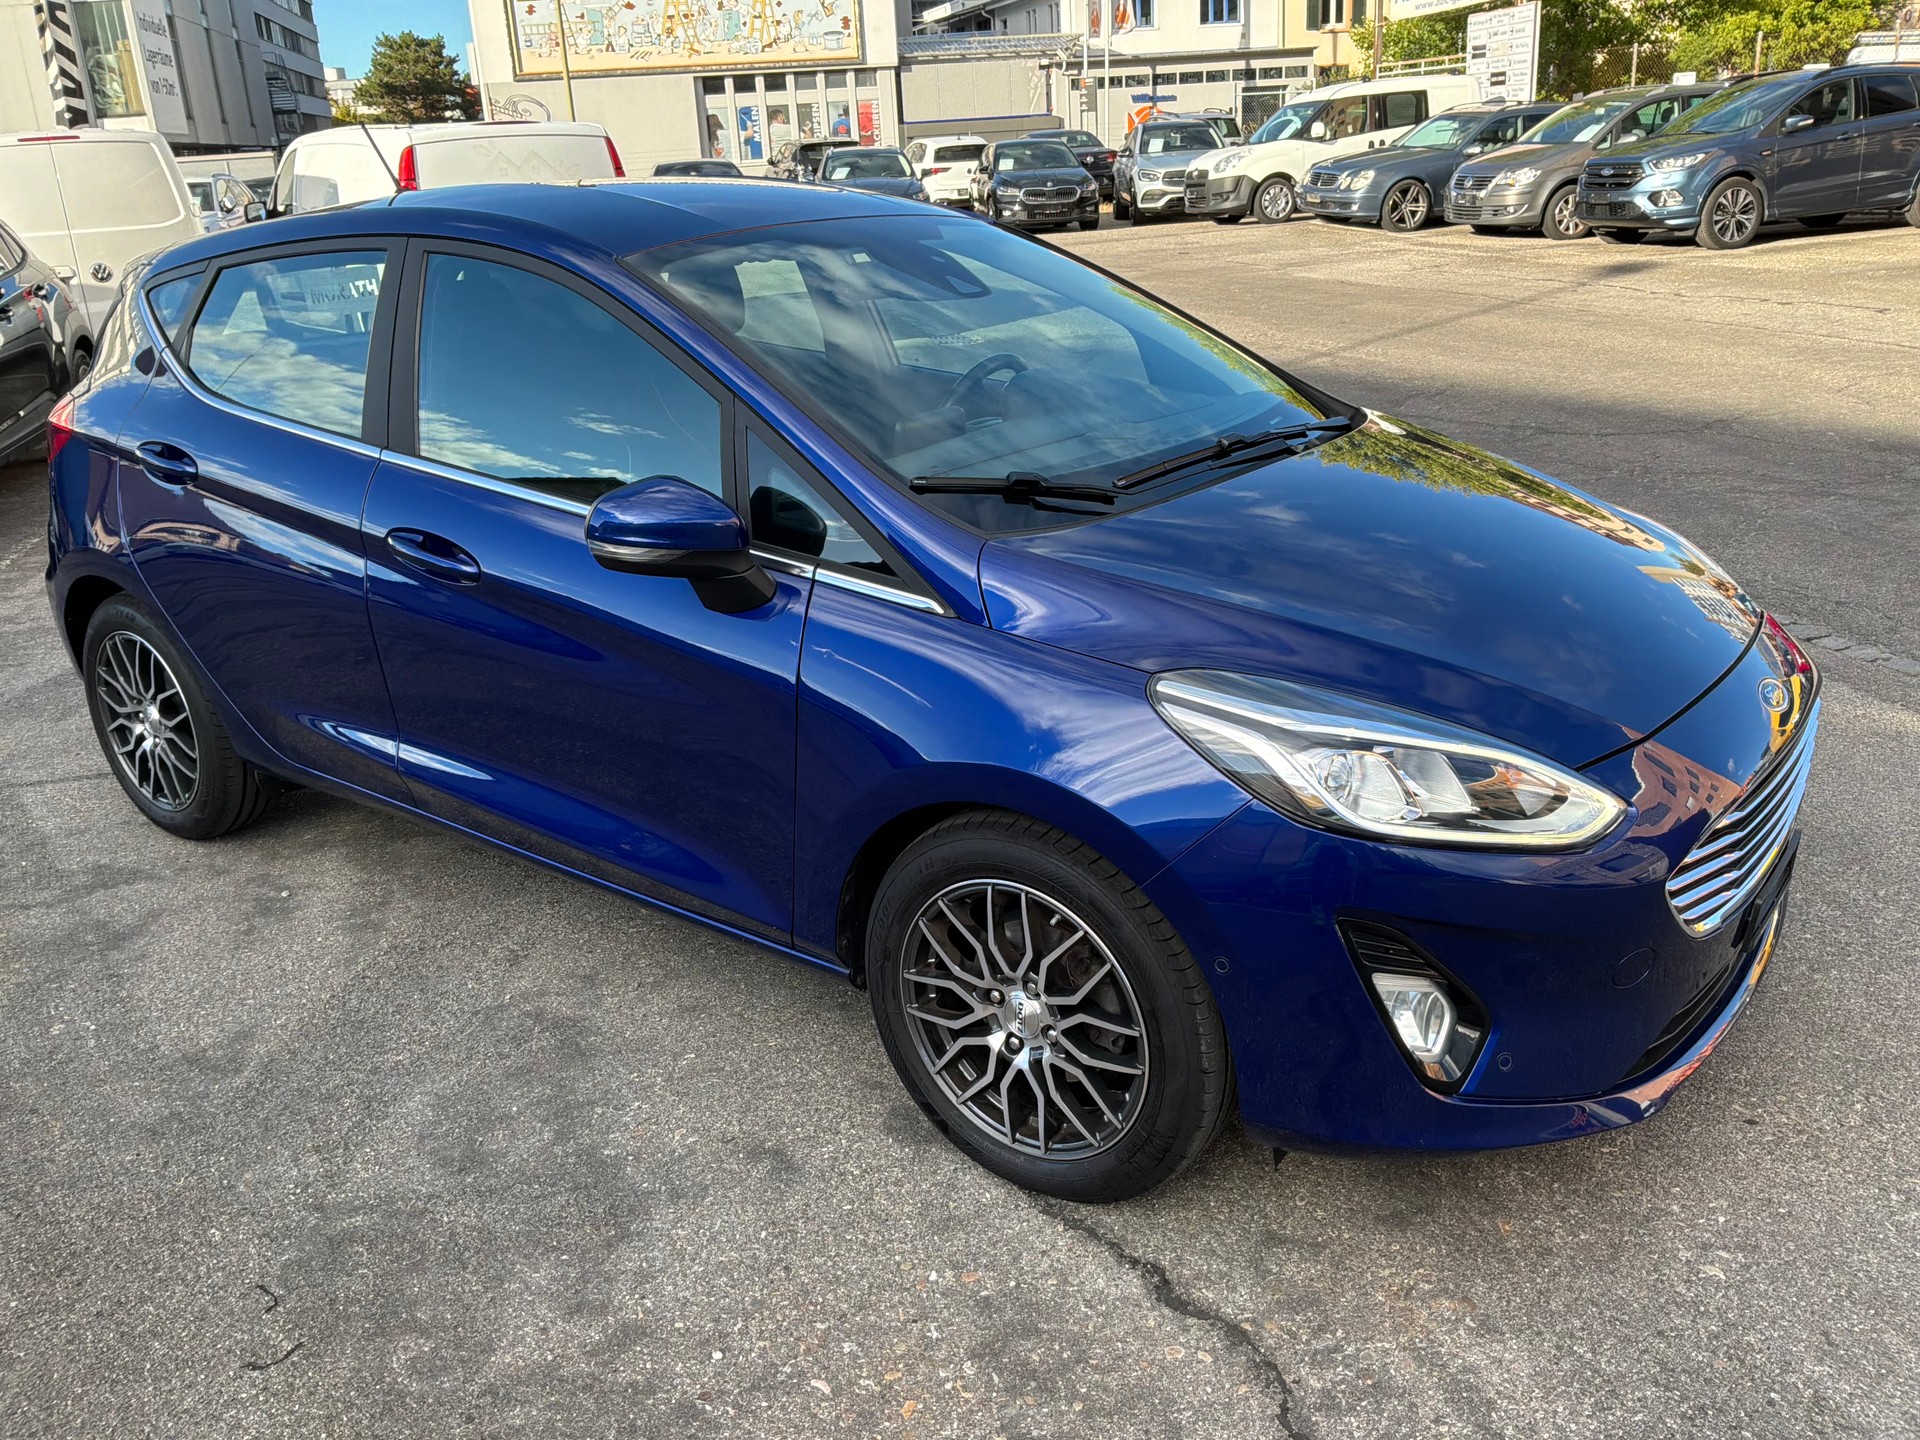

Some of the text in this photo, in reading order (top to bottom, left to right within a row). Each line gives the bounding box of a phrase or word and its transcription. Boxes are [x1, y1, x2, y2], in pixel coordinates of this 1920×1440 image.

[751, 106, 762, 142] MALEN
[811, 103, 822, 139] GIPSEN
[871, 100, 882, 147] ACKIEREN
